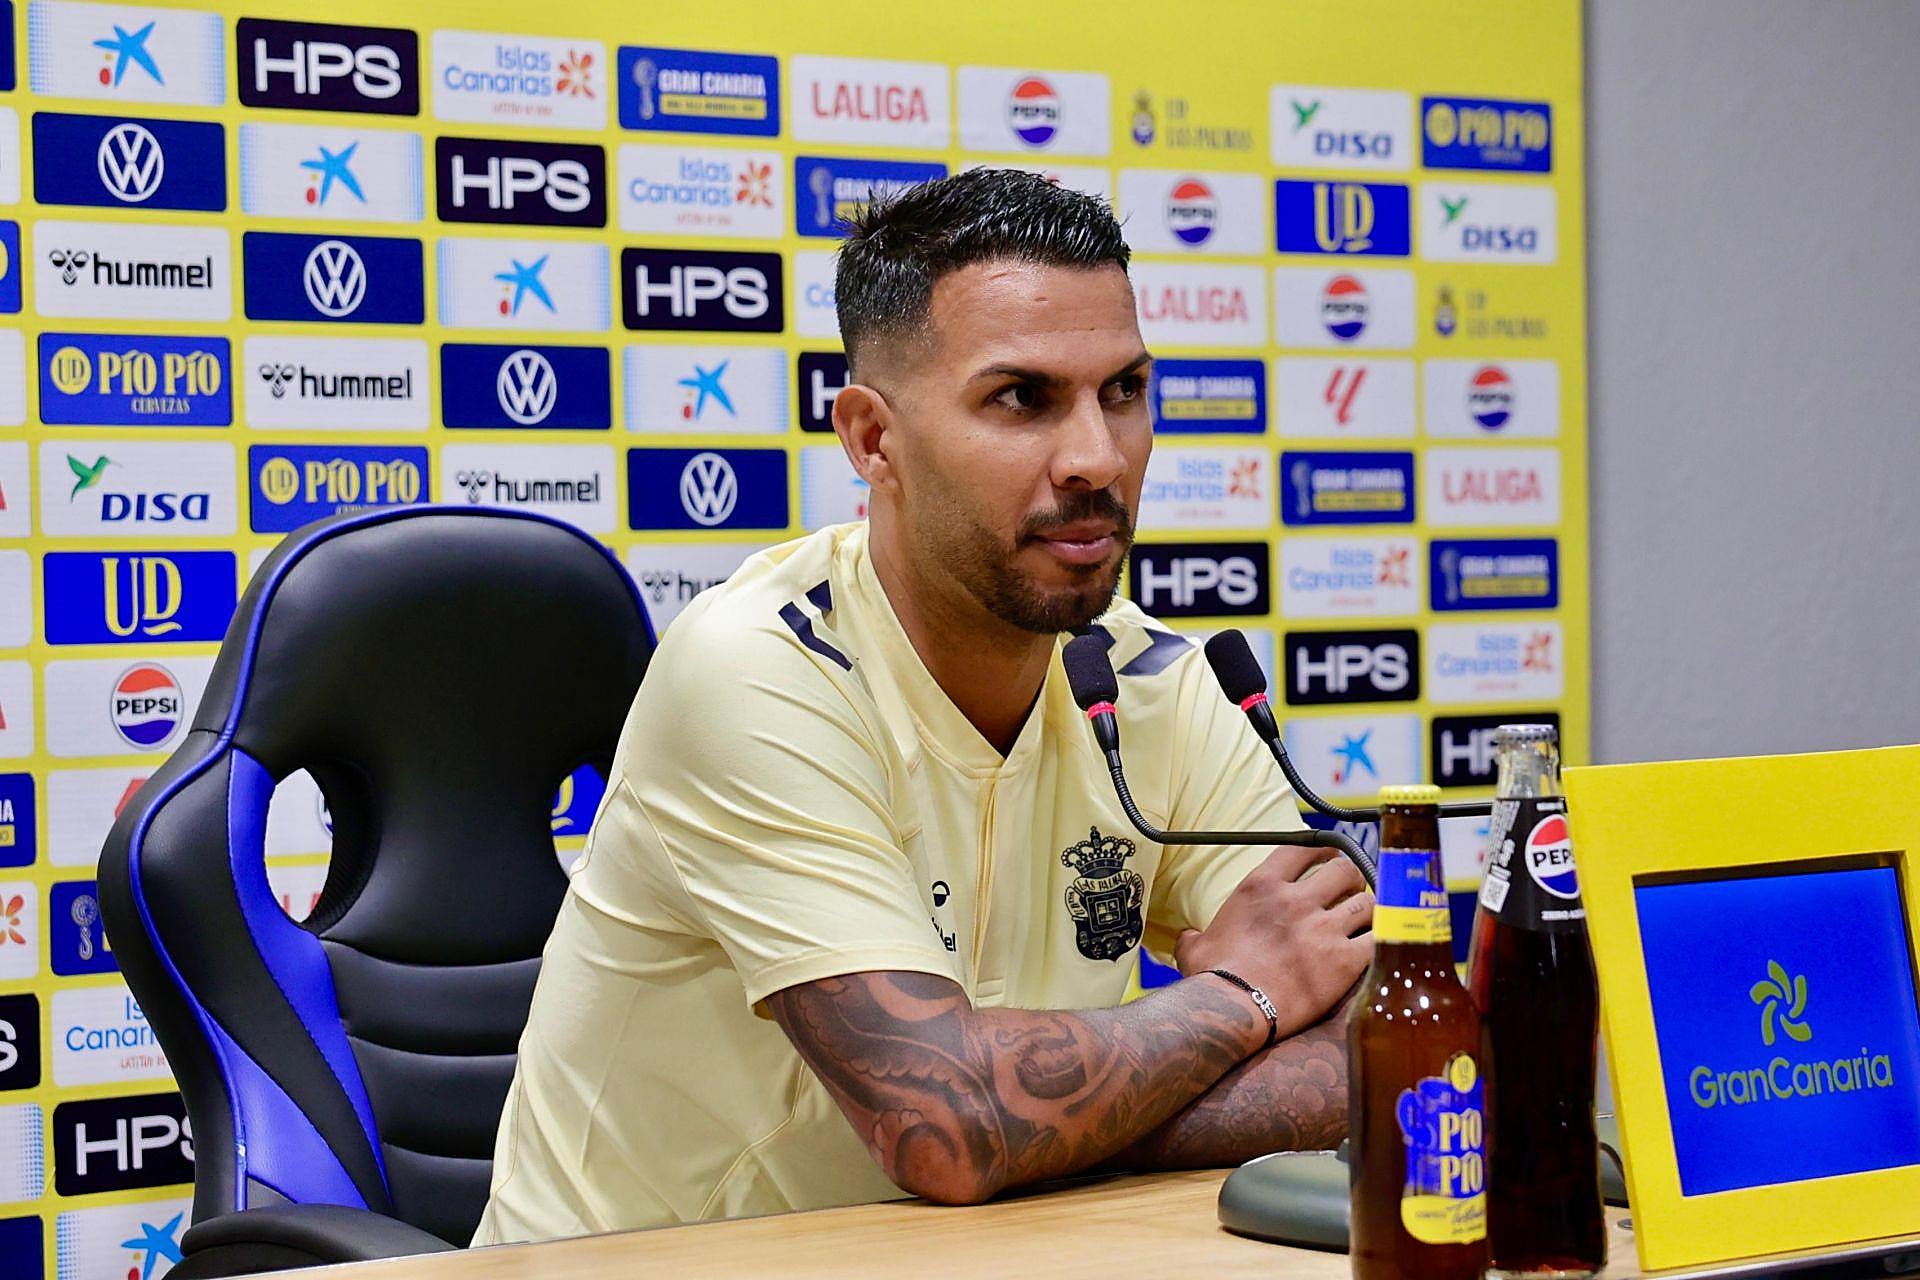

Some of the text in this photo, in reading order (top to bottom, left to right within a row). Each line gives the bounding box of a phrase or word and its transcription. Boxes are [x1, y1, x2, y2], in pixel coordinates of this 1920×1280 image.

[253, 38, 403, 99] HPS
[497, 45, 551, 72] Islas
[444, 66, 552, 97] Canarias
[812, 81, 928, 123] LALIGA
[452, 155, 591, 213] HPS
[679, 157, 731, 182] Islas
[631, 182, 732, 206] Canarias
[93, 252, 212, 289] hummel
[635, 264, 769, 319] HPS
[1140, 288, 1248, 323] LALIGA
[300, 366, 413, 400] hummel
[495, 472, 600, 503] hummel
[1442, 470, 1541, 504] LALIGA
[101, 557, 183, 636] UD
[1140, 557, 1258, 606] HPS
[1296, 643, 1409, 694] HPS
[116, 697, 178, 715] PEPSI
[1533, 848, 1572, 868] PEP
[1689, 1047, 1895, 1109] GranCanaria
